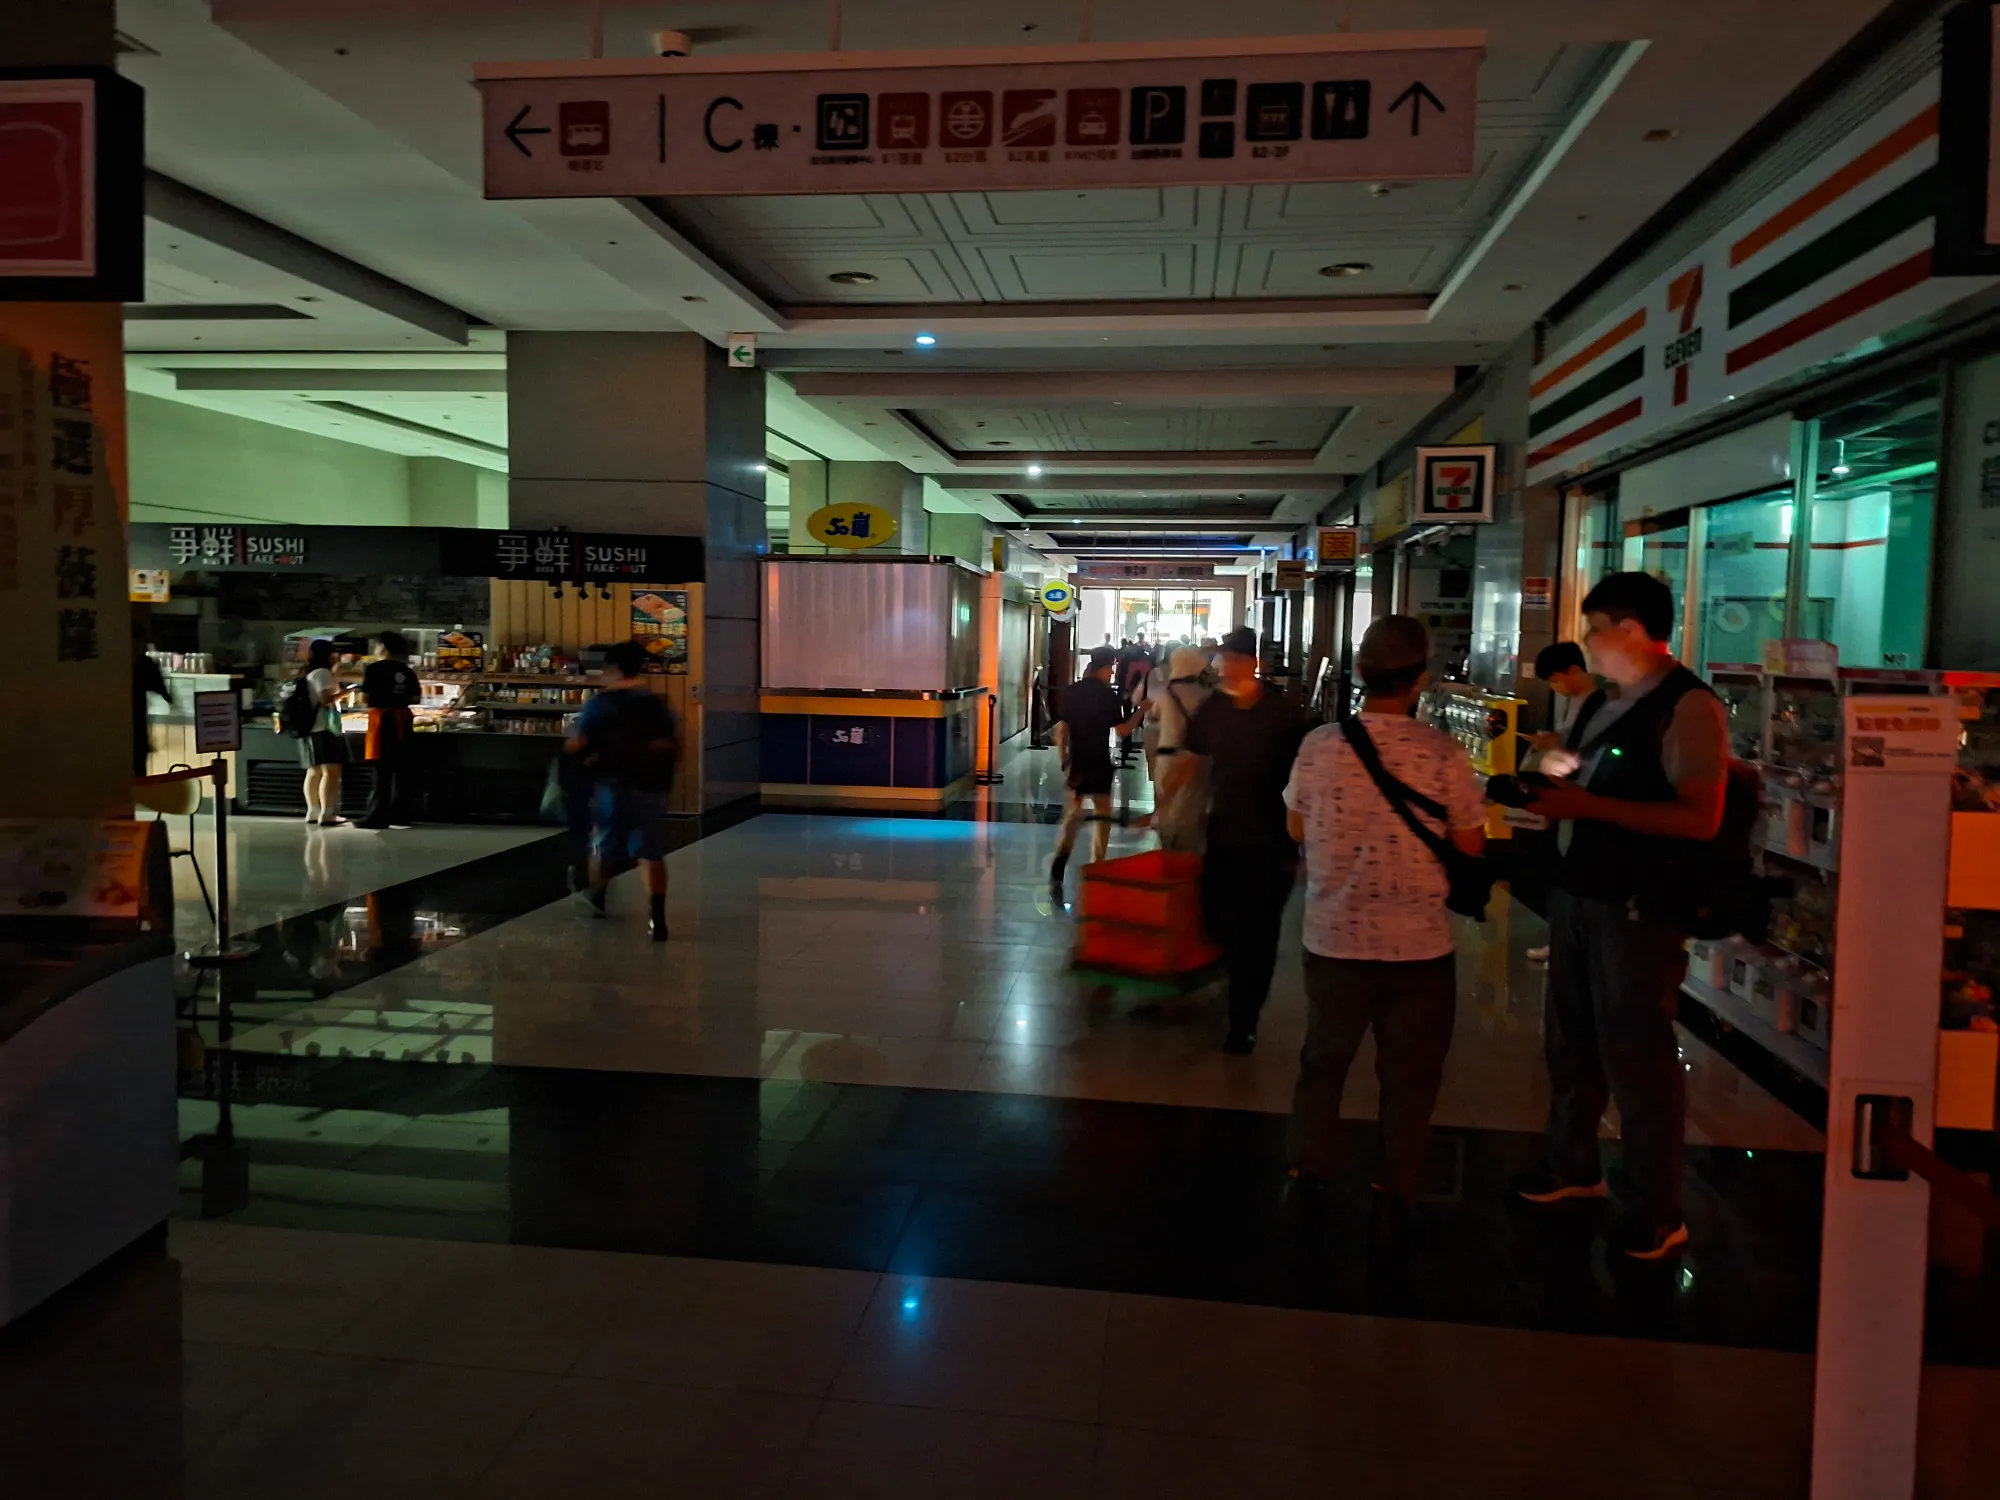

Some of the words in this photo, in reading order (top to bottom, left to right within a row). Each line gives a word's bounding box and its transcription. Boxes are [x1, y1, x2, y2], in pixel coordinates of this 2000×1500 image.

[1667, 264, 1704, 406] 7
[1439, 466, 1471, 509] 7
[168, 527, 234, 566] 爭鮮
[247, 537, 305, 554] SUSHI
[495, 535, 572, 574] 爭鮮
[584, 546, 647, 562] SUSHI
